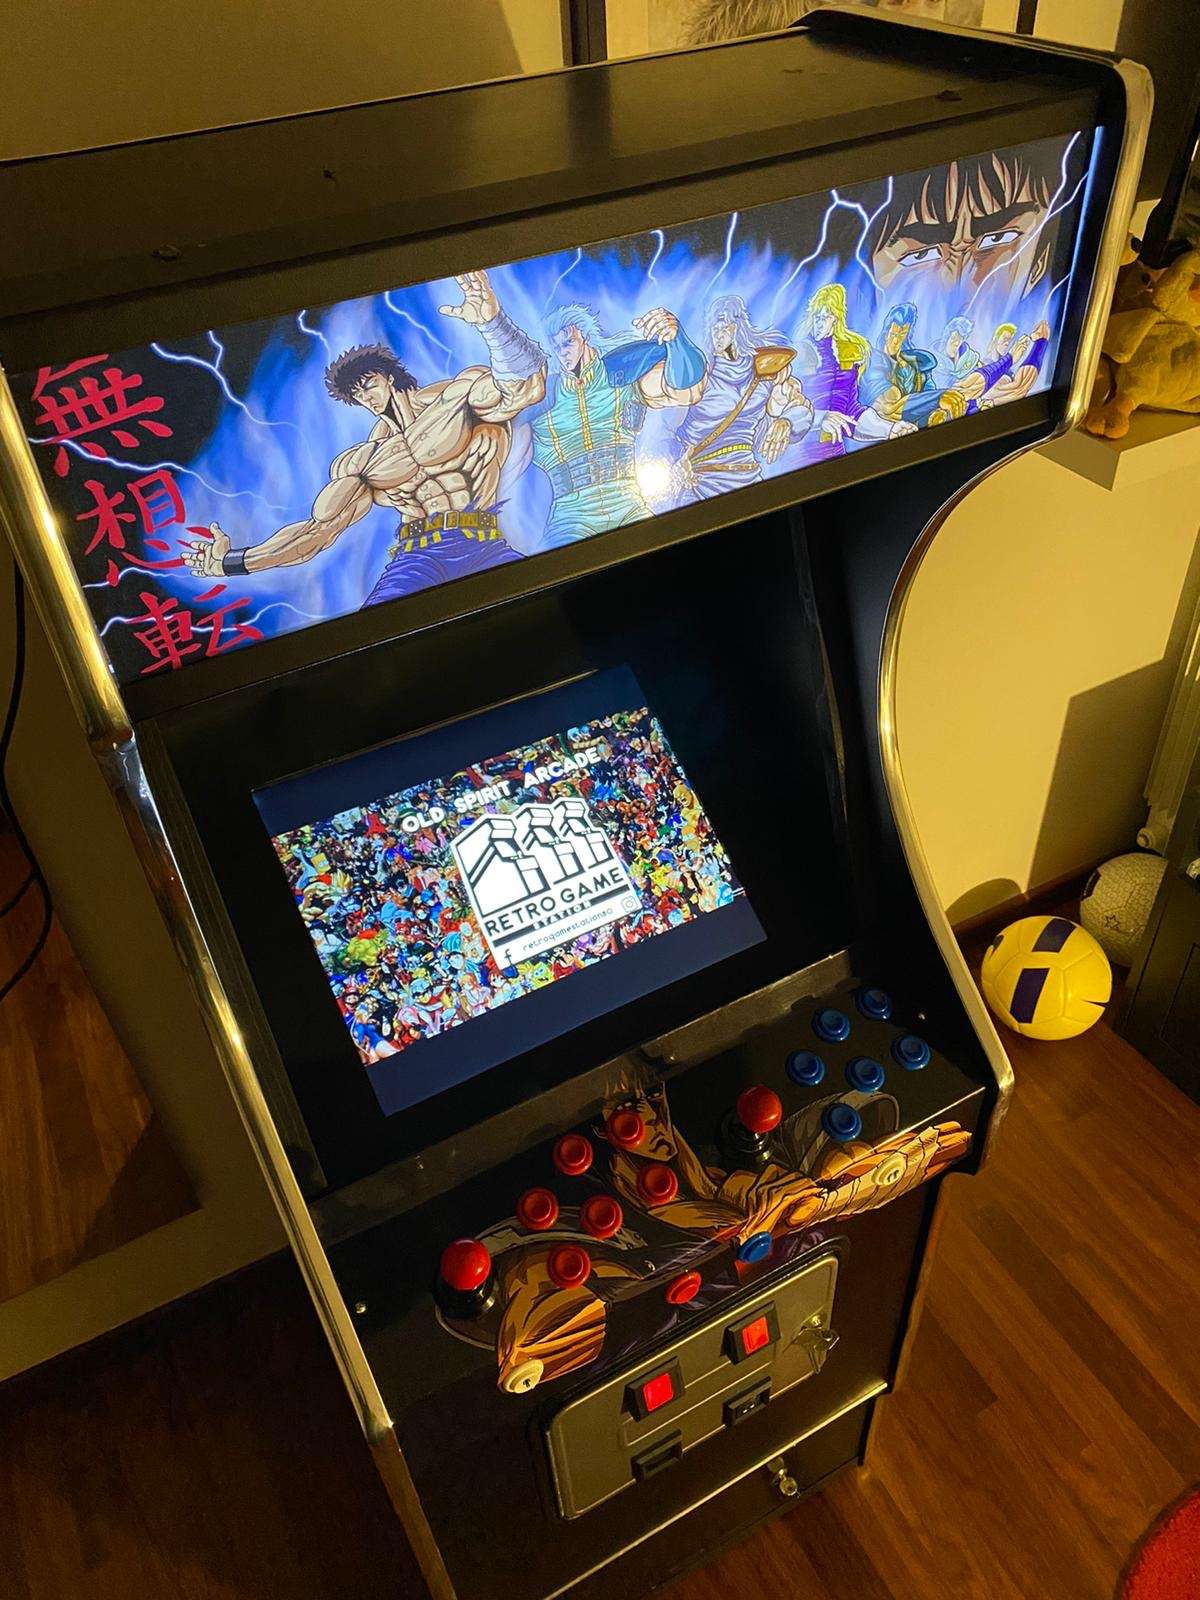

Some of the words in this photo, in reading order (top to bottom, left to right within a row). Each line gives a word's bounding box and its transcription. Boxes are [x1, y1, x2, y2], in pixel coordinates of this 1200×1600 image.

[402, 806, 445, 834] OLD
[454, 781, 511, 814] SPIRIT
[524, 748, 602, 788] ARCADE
[485, 897, 556, 936] RETRO
[561, 868, 624, 903] GAME
[534, 900, 591, 929] STATION
